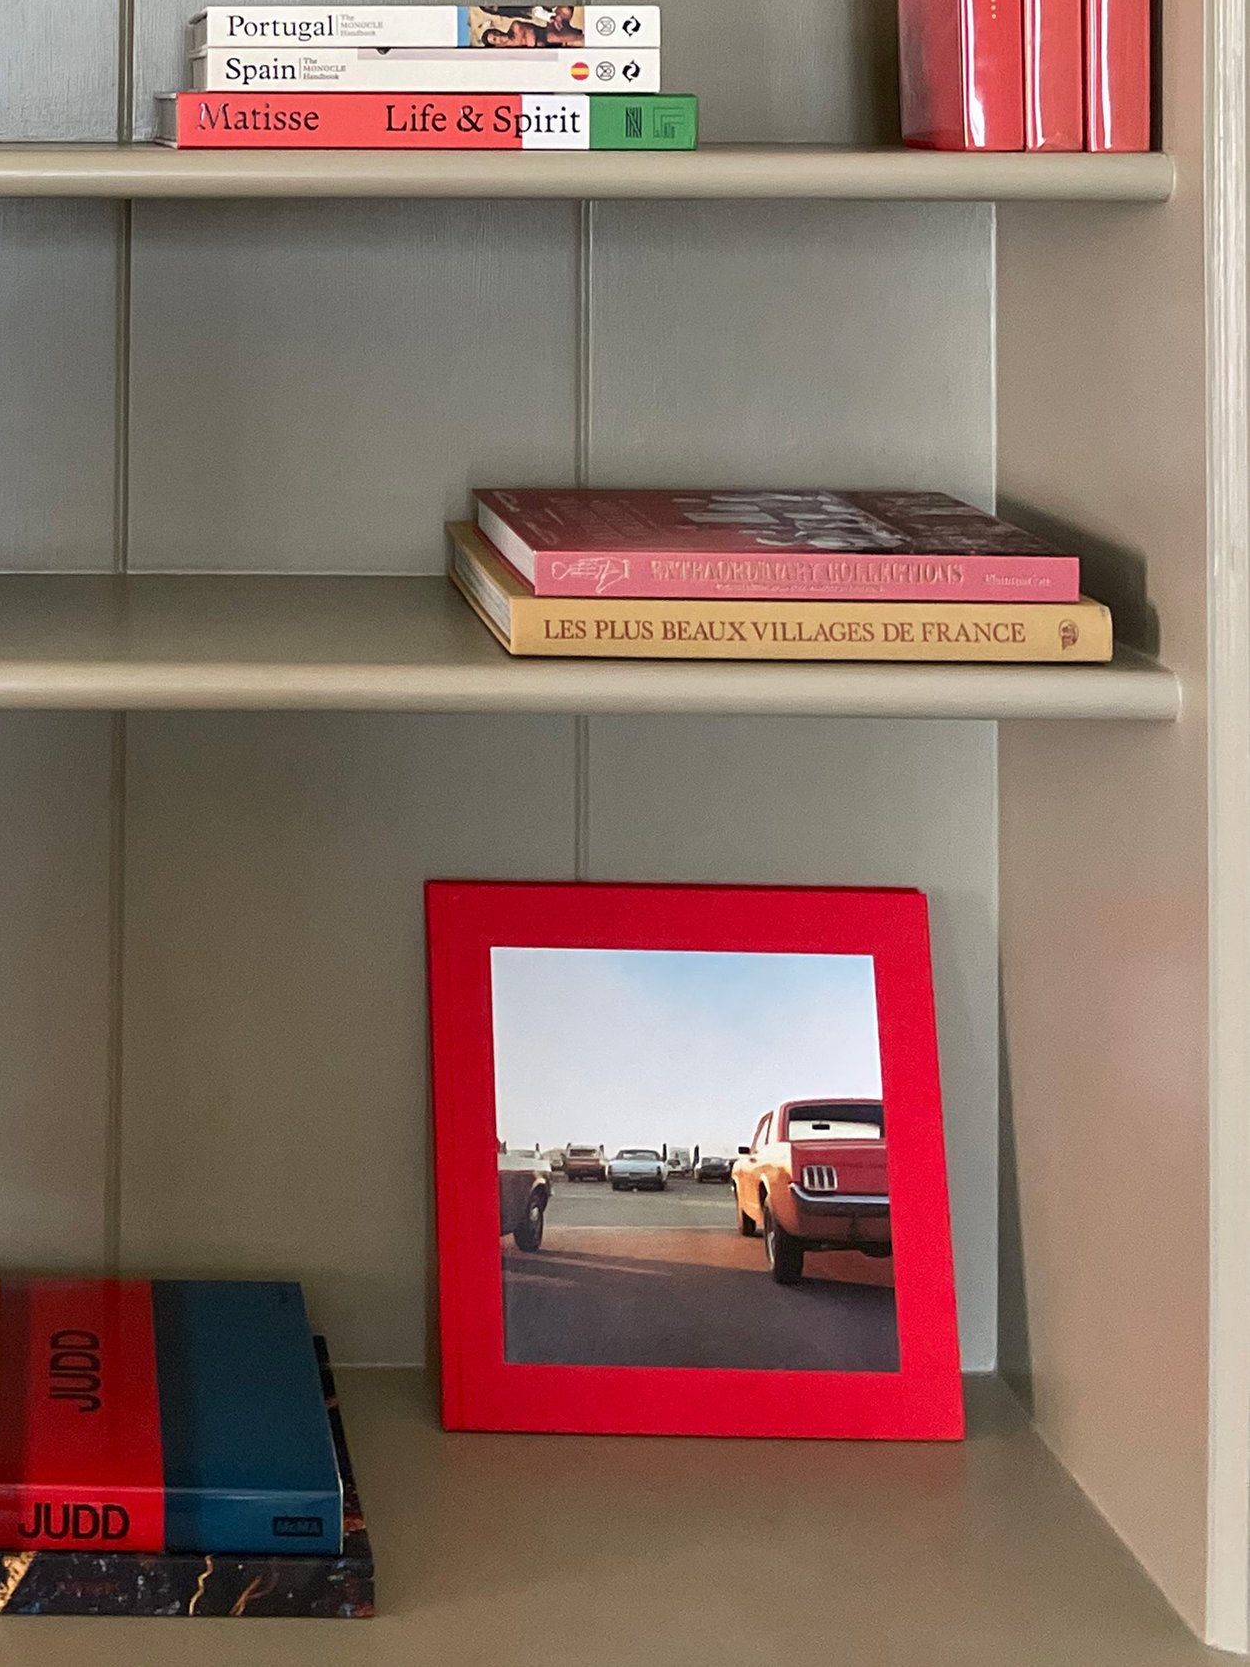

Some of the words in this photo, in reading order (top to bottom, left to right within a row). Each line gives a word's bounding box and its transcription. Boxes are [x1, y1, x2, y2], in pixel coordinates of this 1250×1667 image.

[226, 14, 334, 42] Portugal
[225, 57, 297, 86] Spain
[303, 57, 317, 65] The
[303, 73, 340, 81] Handbook
[198, 101, 320, 131] Matisse
[385, 102, 447, 132] Life
[456, 105, 484, 132] &
[492, 104, 581, 139] Spirit
[543, 619, 587, 640] LES
[594, 619, 654, 641] PLUS
[660, 620, 747, 642] BEAUX
[752, 620, 876, 644] VILLAGES
[881, 622, 915, 644] DE
[919, 622, 1027, 644] FRANCE
[50, 1329, 103, 1413] JUDD
[17, 1502, 131, 1541] JUDD
